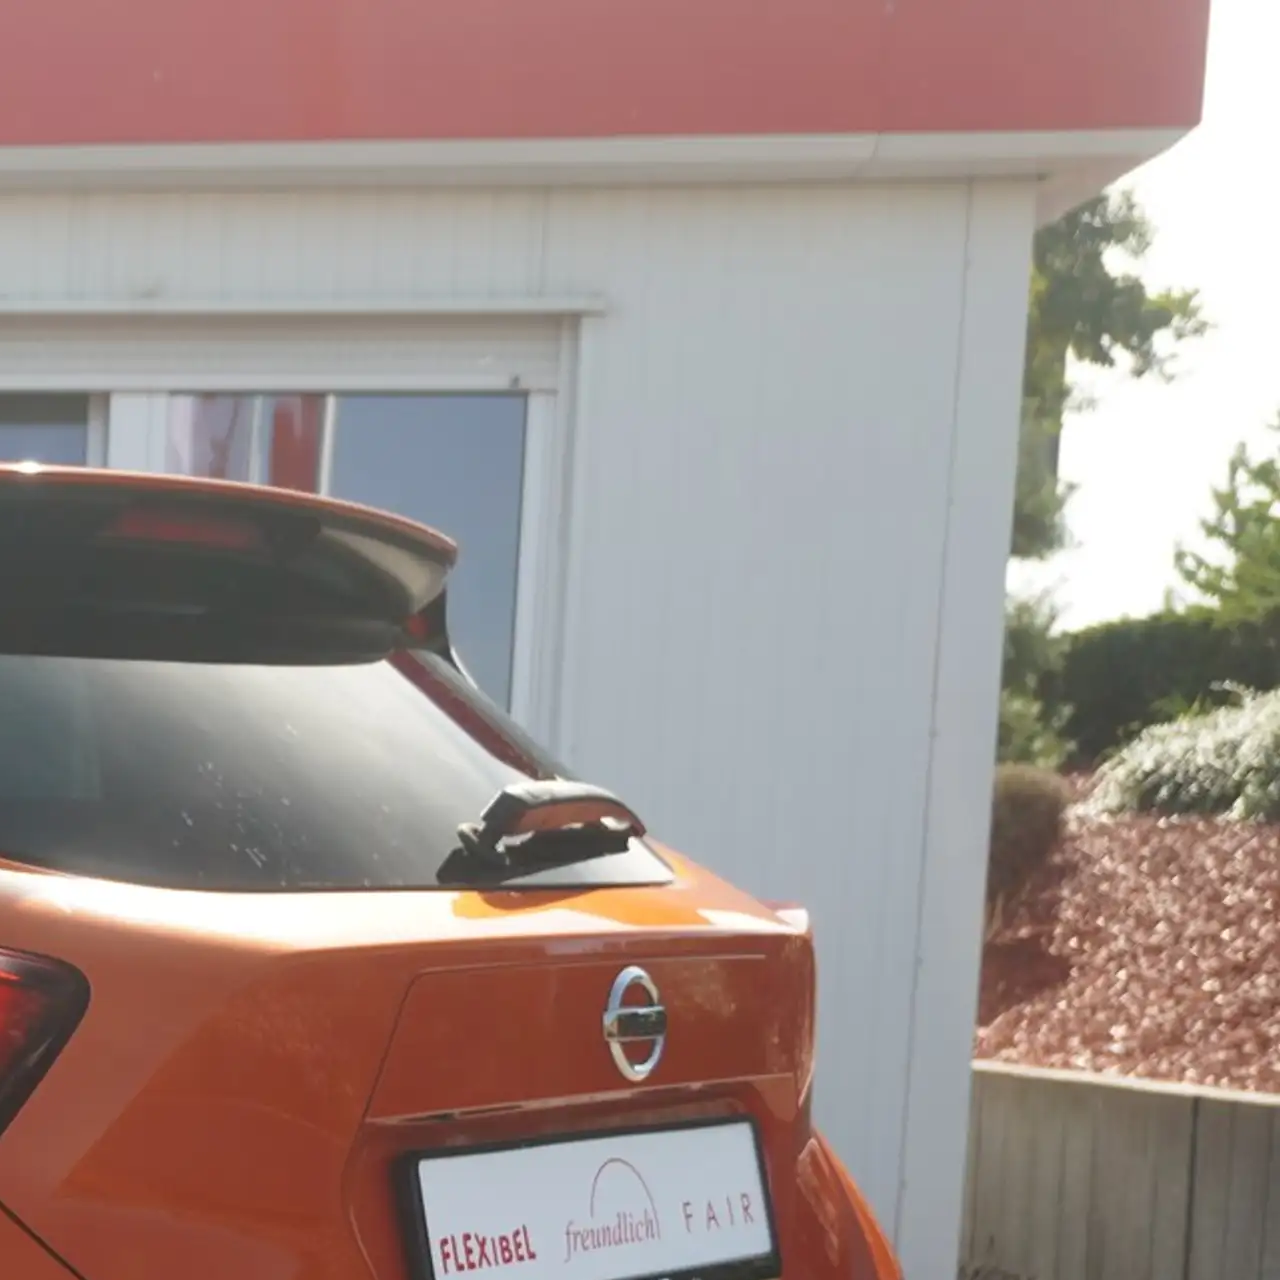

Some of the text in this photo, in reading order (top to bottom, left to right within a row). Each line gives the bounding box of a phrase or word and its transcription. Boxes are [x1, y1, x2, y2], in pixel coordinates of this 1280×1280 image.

[439, 1193, 755, 1275] FLEXIBEL freundlich FAIR
